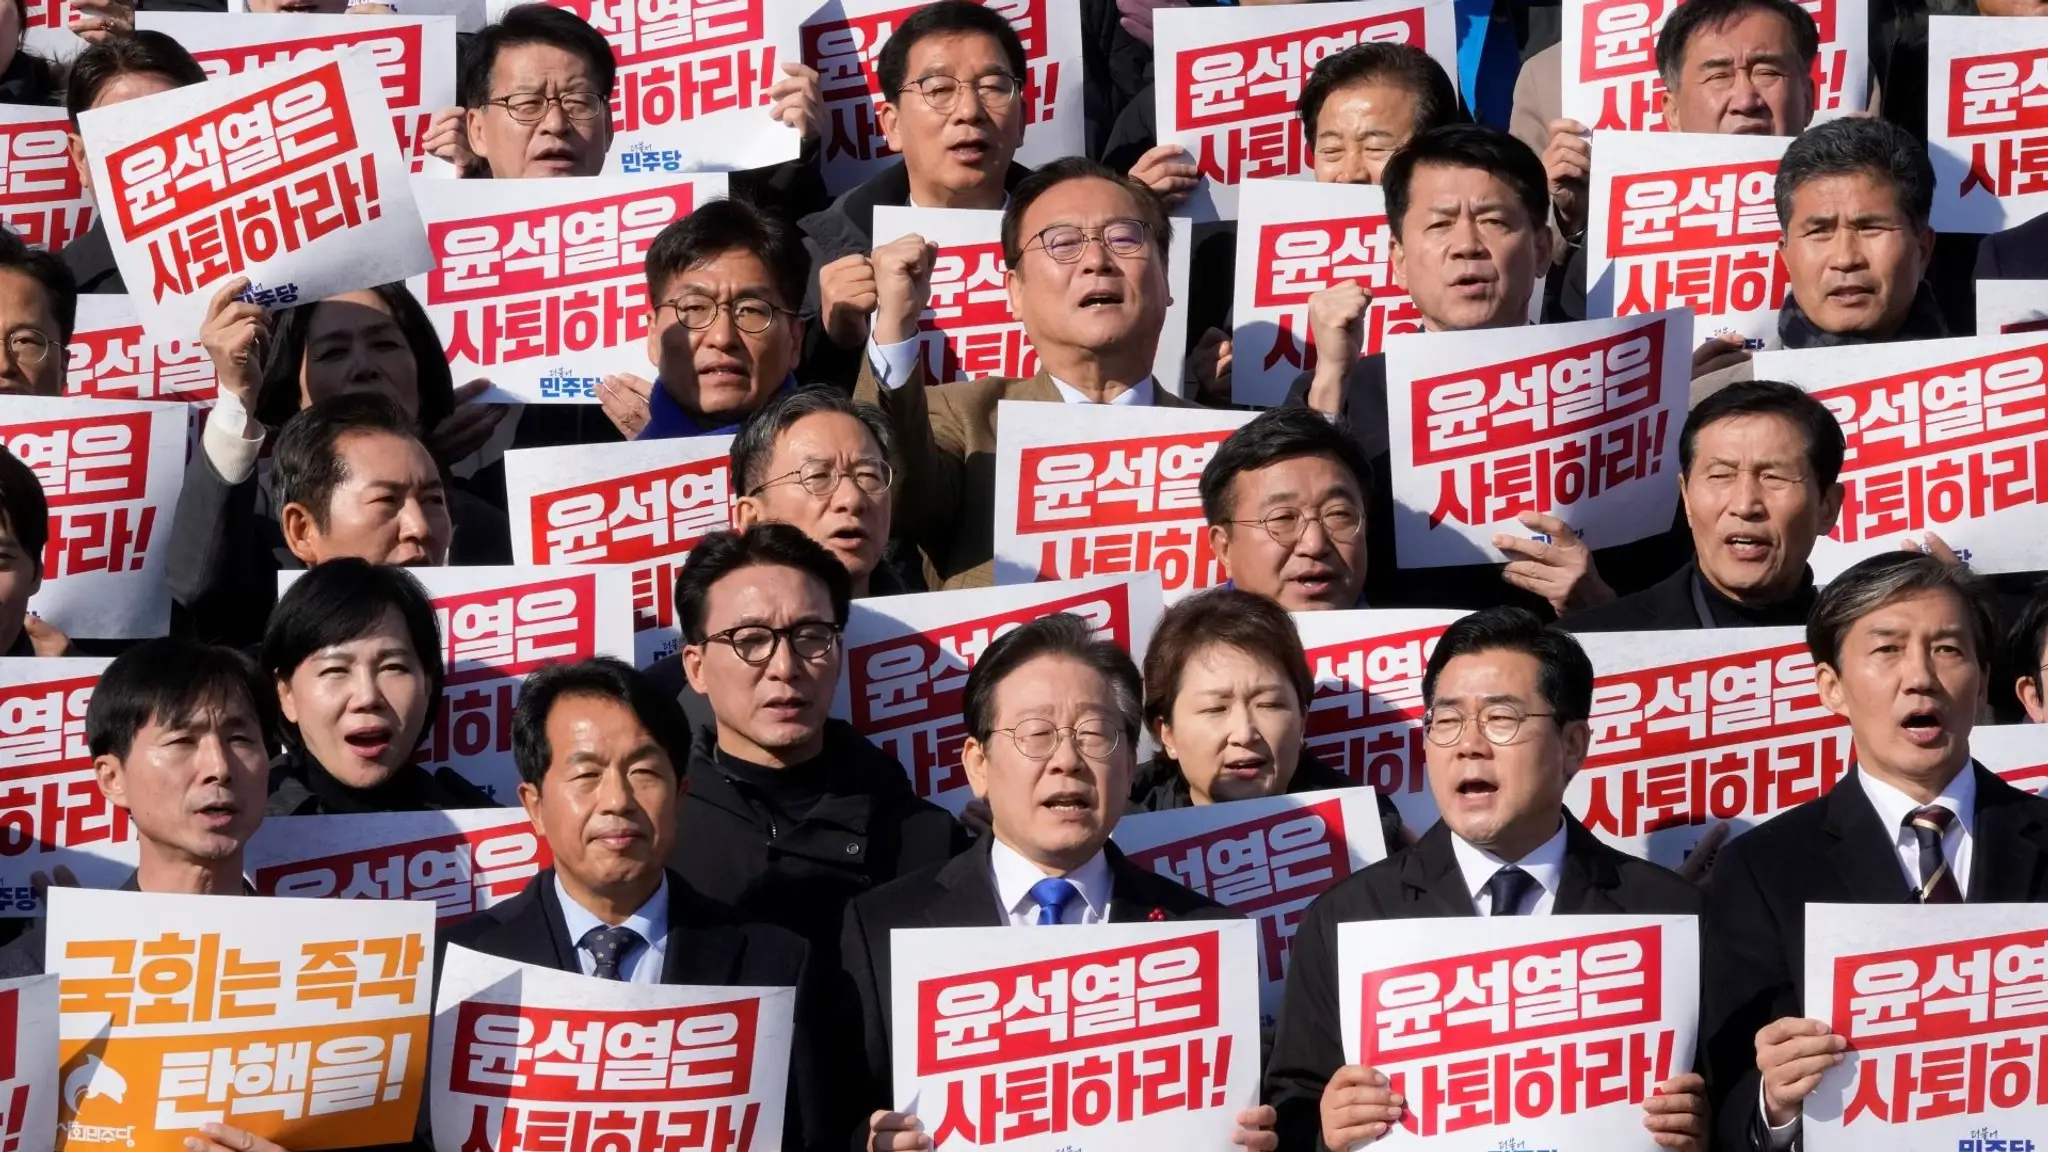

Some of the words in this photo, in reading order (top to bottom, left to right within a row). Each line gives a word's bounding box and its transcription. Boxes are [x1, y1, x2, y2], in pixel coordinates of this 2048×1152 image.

[558, 0, 748, 57] 석열은
[121, 80, 339, 226] 윤석열은
[621, 150, 682, 173] 민주당
[1197, 119, 1315, 185] 사퇴
[148, 153, 381, 304] 사퇴하라!
[442, 195, 676, 292] 윤석열은
[1427, 335, 1651, 453] 윤석열은
[546, 466, 737, 565] 윤석열
[1429, 408, 1669, 531] 사퇴하라!
[42, 506, 157, 580] 라!
[436, 588, 578, 674] 열은
[1307, 636, 1442, 719] 석열
[1588, 652, 1835, 758] 윤석열은
[59, 932, 281, 1027] 국회는
[295, 933, 424, 1010] 즉각
[935, 946, 1202, 1061] 윤석열은
[1376, 939, 1645, 1052] 윤석열은
[1850, 941, 2048, 1039] 윤석열
[154, 1033, 412, 1130] 탄핵을!
[468, 1012, 739, 1091] 윤석열은
[933, 1034, 1233, 1150] 사퇴하라!
[1376, 1030, 1675, 1139] 사퇴하라!
